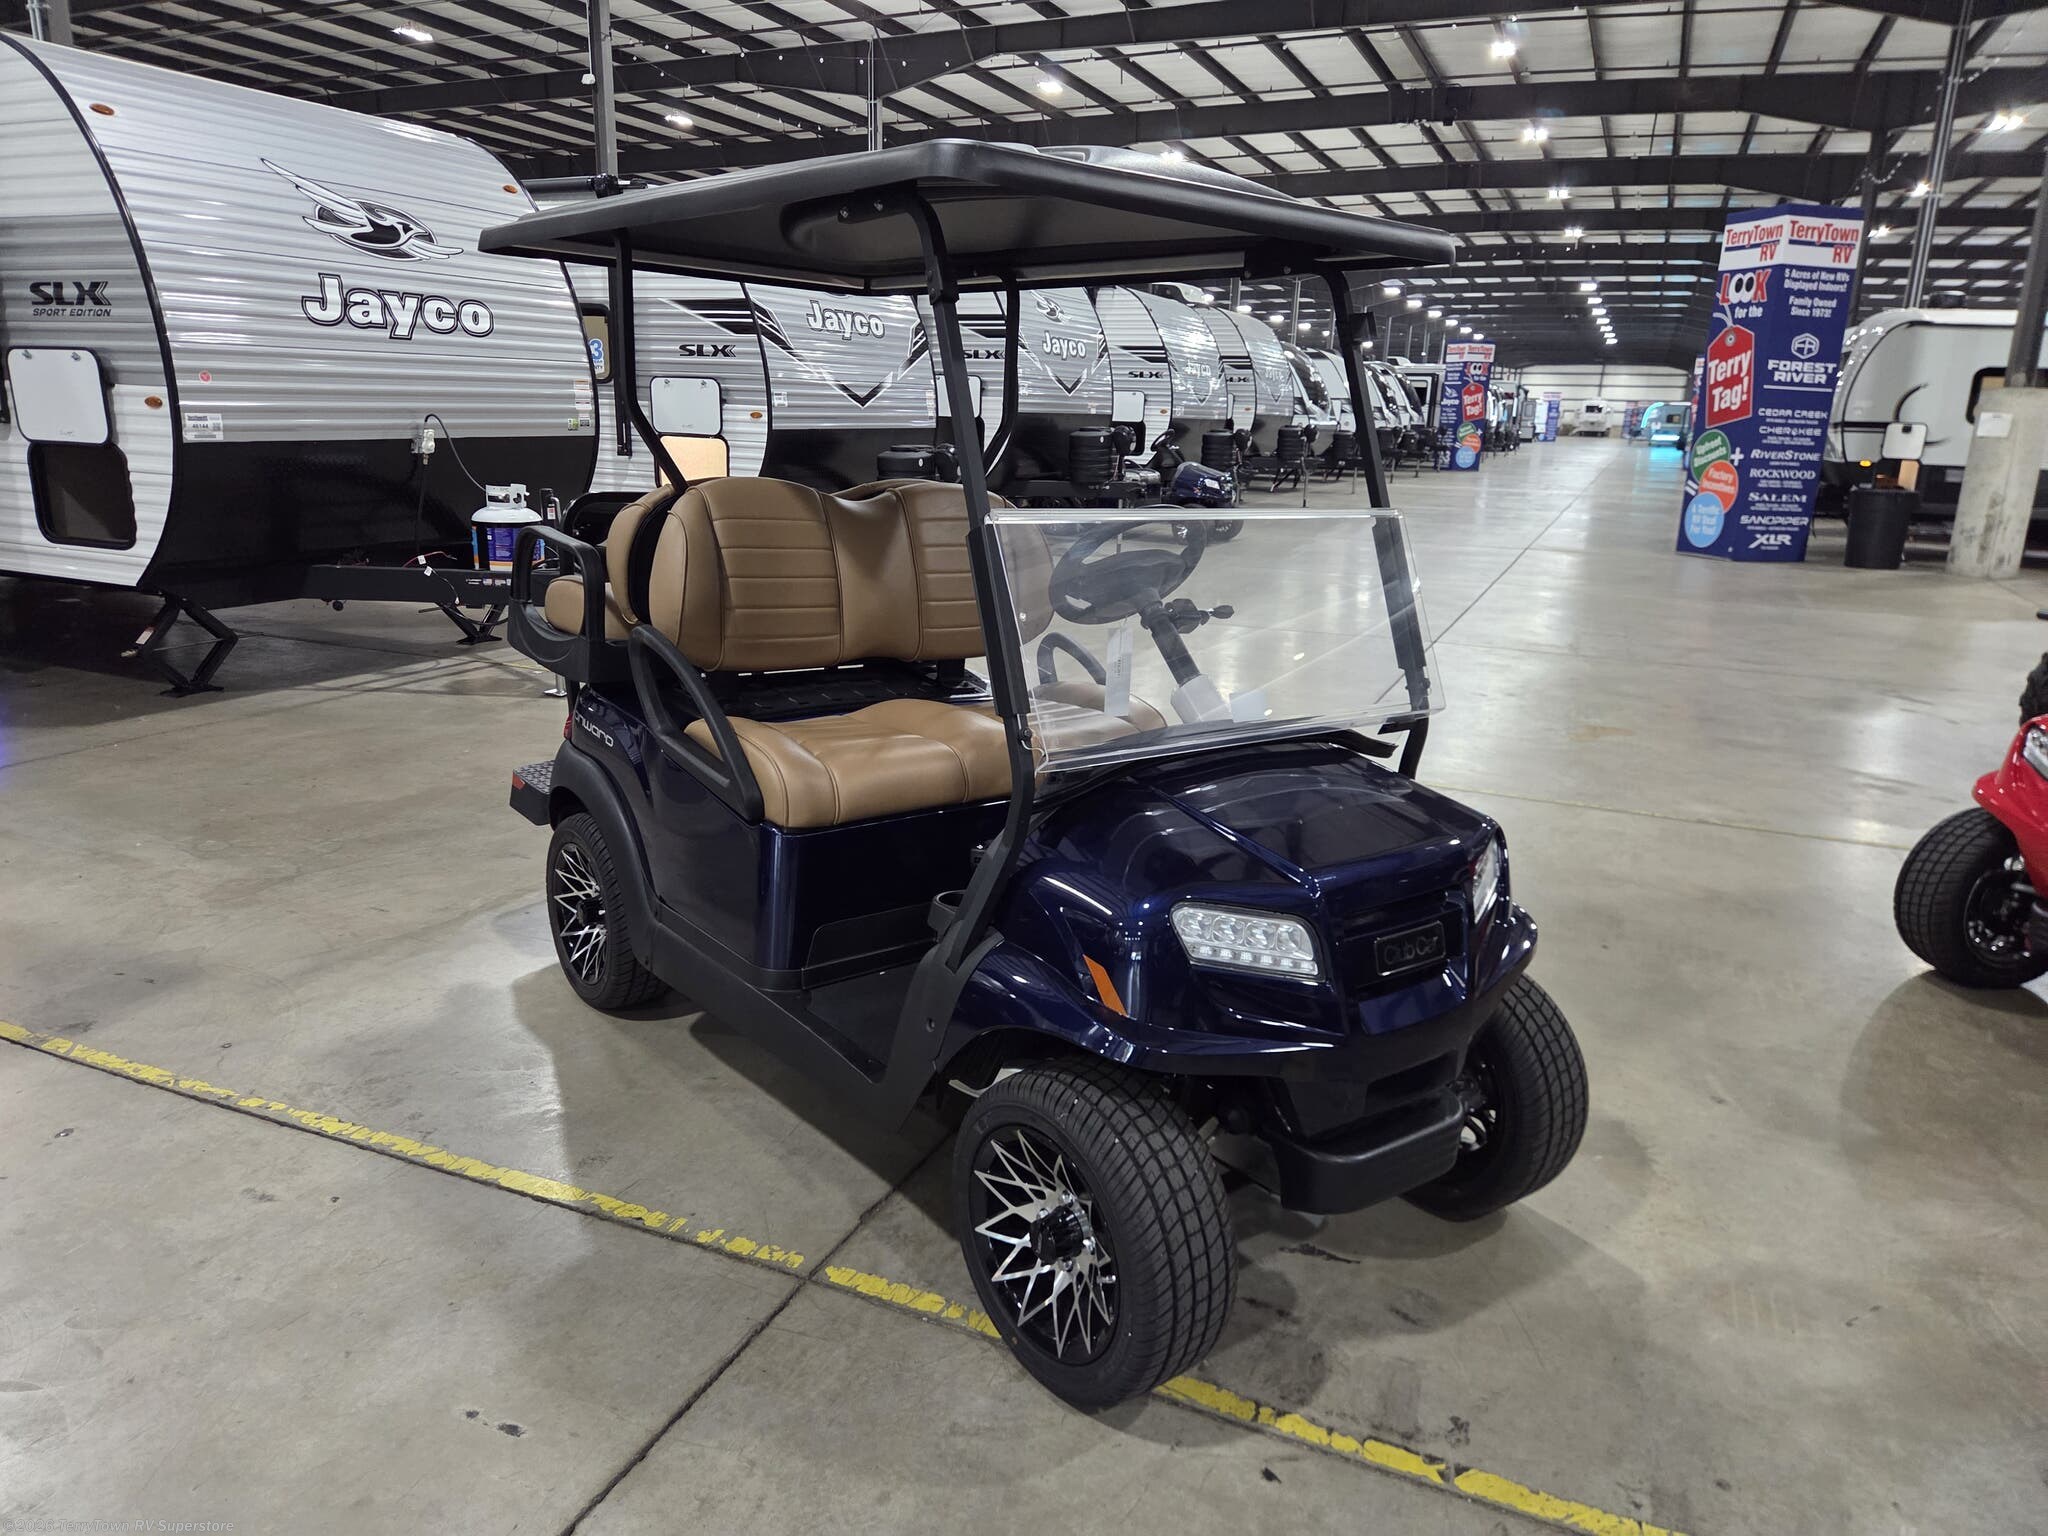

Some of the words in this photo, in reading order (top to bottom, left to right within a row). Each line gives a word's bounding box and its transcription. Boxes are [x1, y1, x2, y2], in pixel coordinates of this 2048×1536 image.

[1726, 224, 1784, 247] TerryTown
[1790, 220, 1859, 245] TerryTown
[1759, 243, 1778, 262] RV
[1833, 245, 1855, 264] RV
[1784, 268, 1790, 278] 5
[1791, 269, 1811, 279] Acres
[1811, 270, 1820, 280] of
[1820, 271, 1836, 281] New
[1836, 272, 1850, 282] RVs
[1719, 268, 1772, 305] LOOK
[1784, 278, 1818, 291] Displayed
[29, 281, 109, 306] SLX
[301, 273, 494, 340] Jayco
[1789, 295, 1812, 308] Family
[1813, 297, 1837, 308] Owned
[33, 308, 67, 317] SPORT
[70, 308, 112, 317] EDITION
[1734, 305, 1748, 319] for
[1749, 305, 1763, 318] the
[1790, 306, 1811, 317] Since
[806, 300, 885, 340] Jayco
[589, 339, 603, 360] 3
[679, 344, 735, 357] SLX
[1042, 330, 1087, 361] Jayco
[963, 349, 1004, 359] SLX
[1708, 350, 1752, 384] Terry
[1767, 359, 1837, 374] FOREST
[1773, 371, 1827, 385] RIVER
[1463, 392, 1485, 406] Terry
[1712, 376, 1750, 412] Tag!
[1758, 408, 1793, 418] CEDAR
[1794, 410, 1829, 420] CREEK
[1758, 425, 1822, 437] CHEROKEE
[1749, 468, 1817, 480] ROCKWOOD
[1748, 492, 1808, 503] SALEM
[1740, 515, 1809, 526] SANDPIPER
[1748, 533, 1792, 549] XLR
